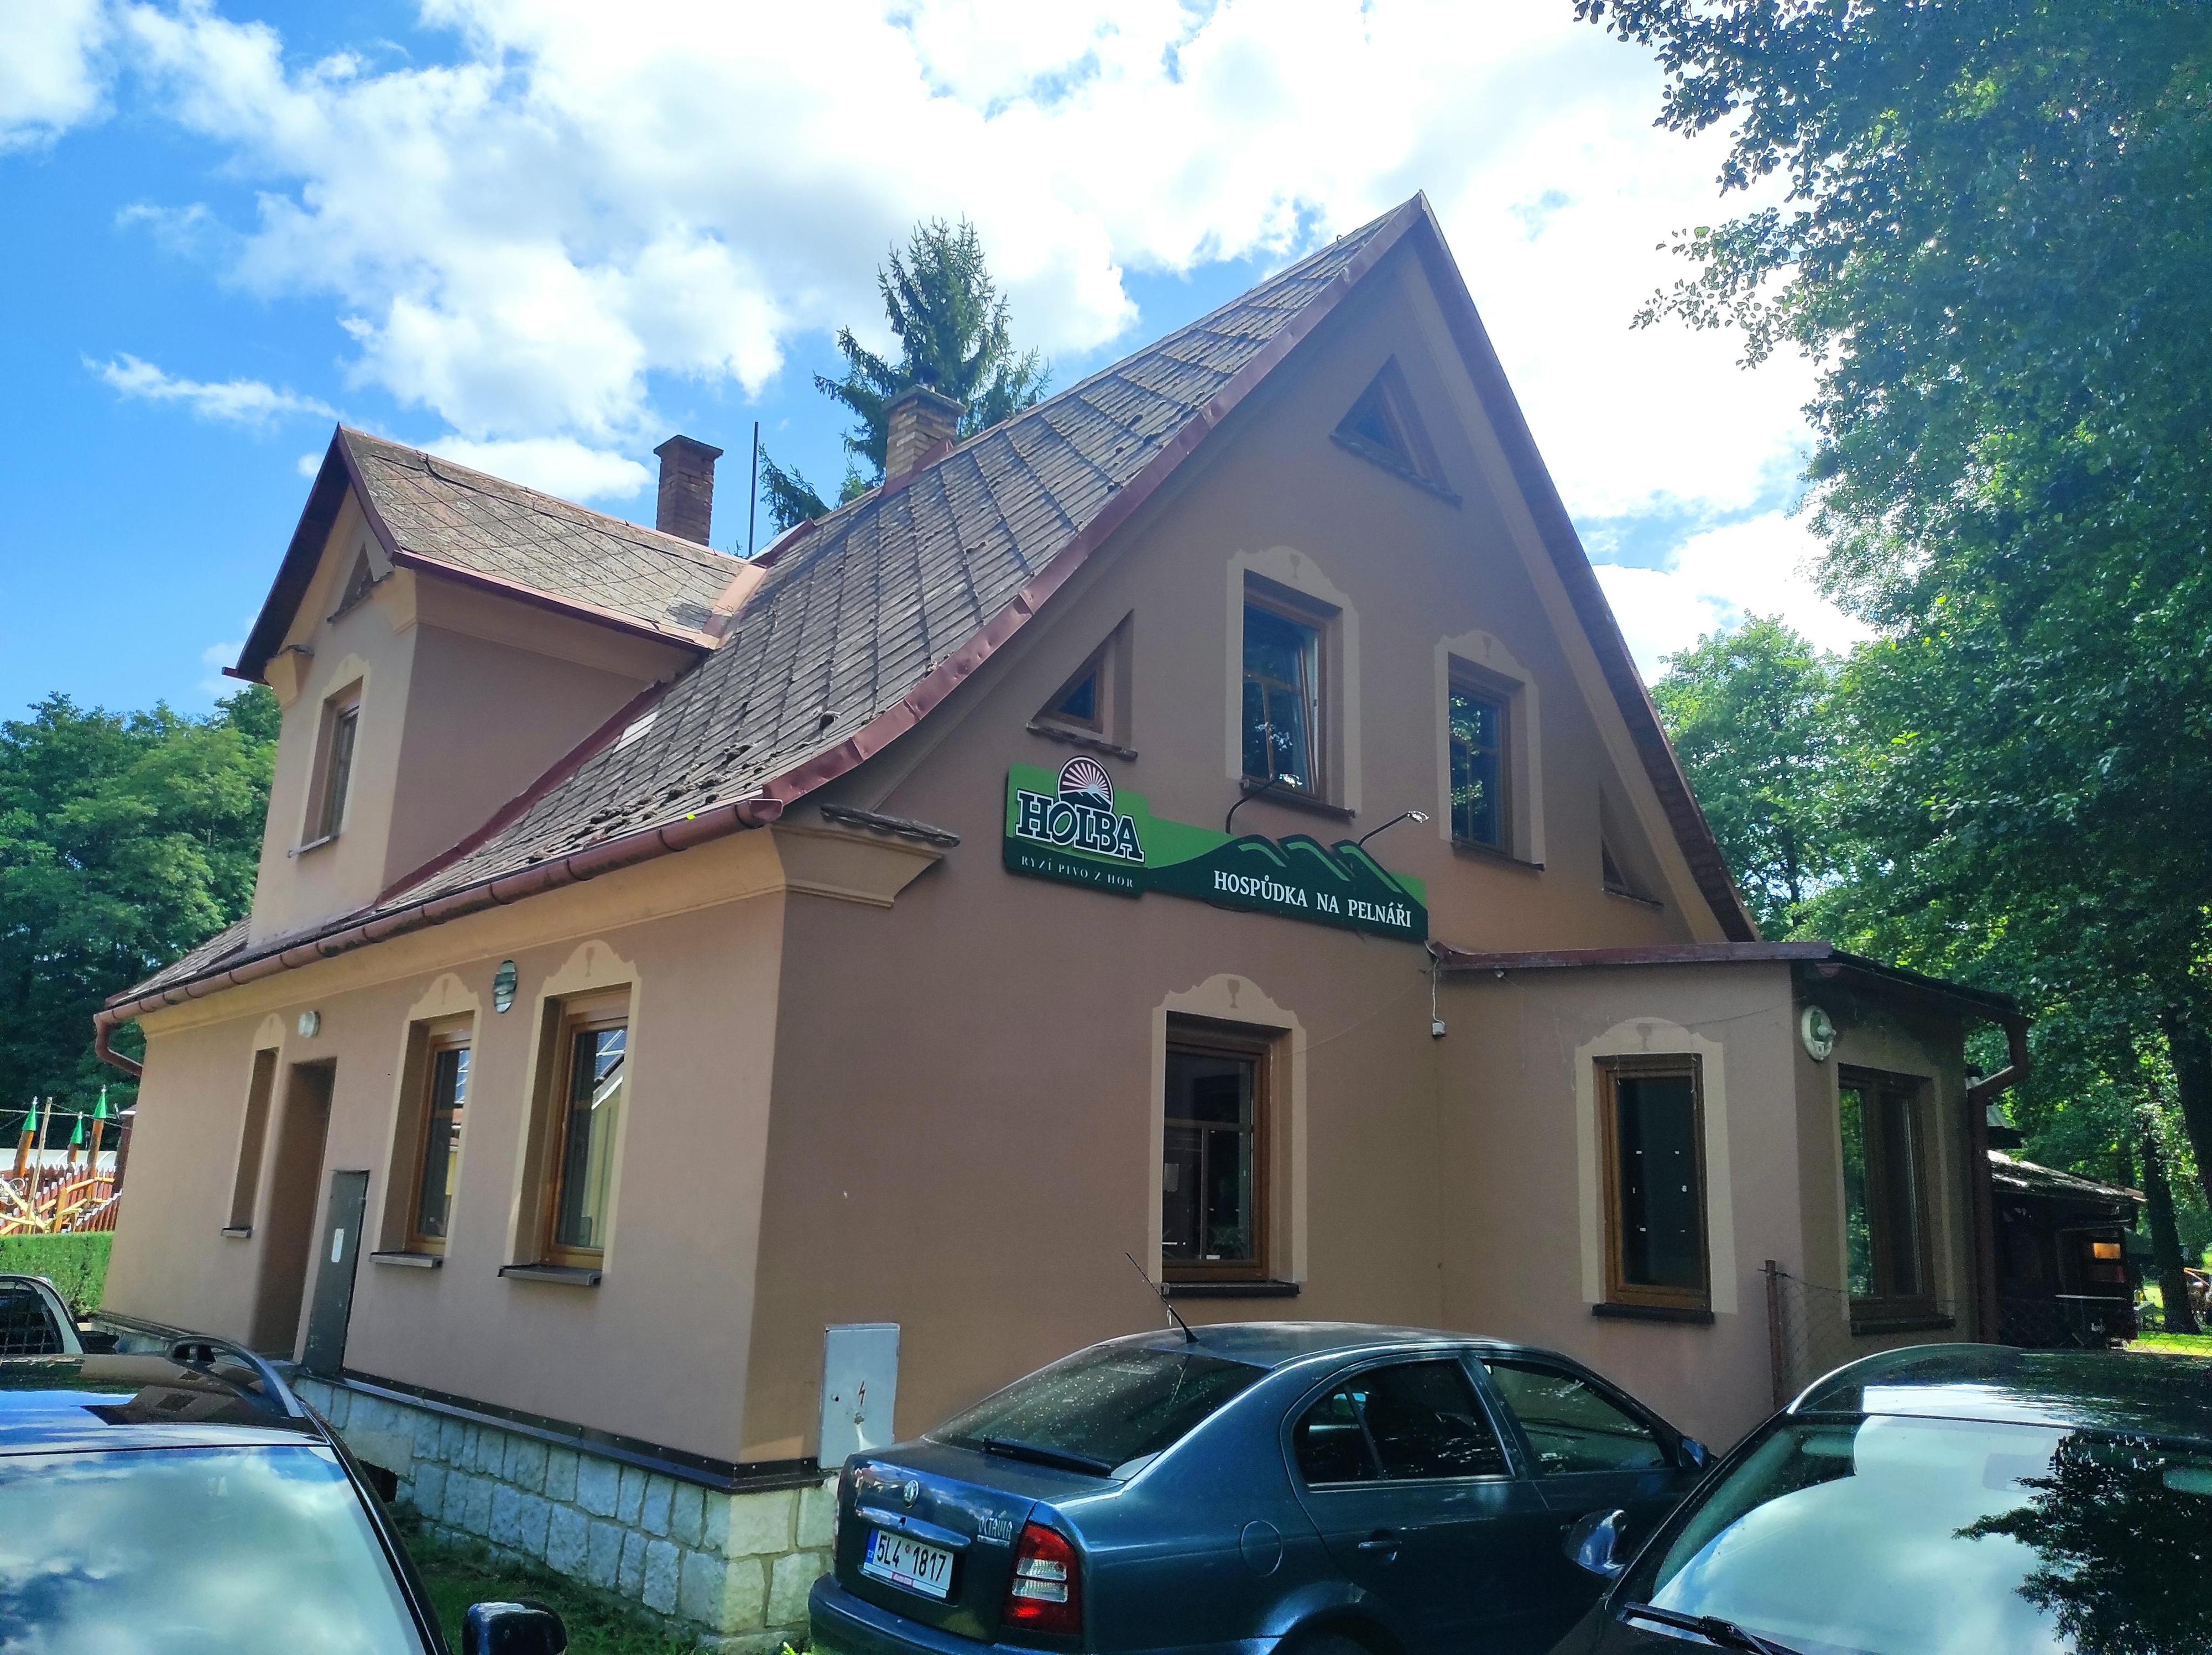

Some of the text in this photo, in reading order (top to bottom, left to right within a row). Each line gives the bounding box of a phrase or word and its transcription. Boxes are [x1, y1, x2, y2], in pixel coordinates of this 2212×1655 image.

[1015, 788, 1145, 862] HOLBA
[1021, 855, 1133, 888] RYZÍ PIVO Z HOR
[1214, 870, 1411, 928] HOSPŮDKA NA PELNÁŘI
[877, 1534, 947, 1582] 5L4 1817
